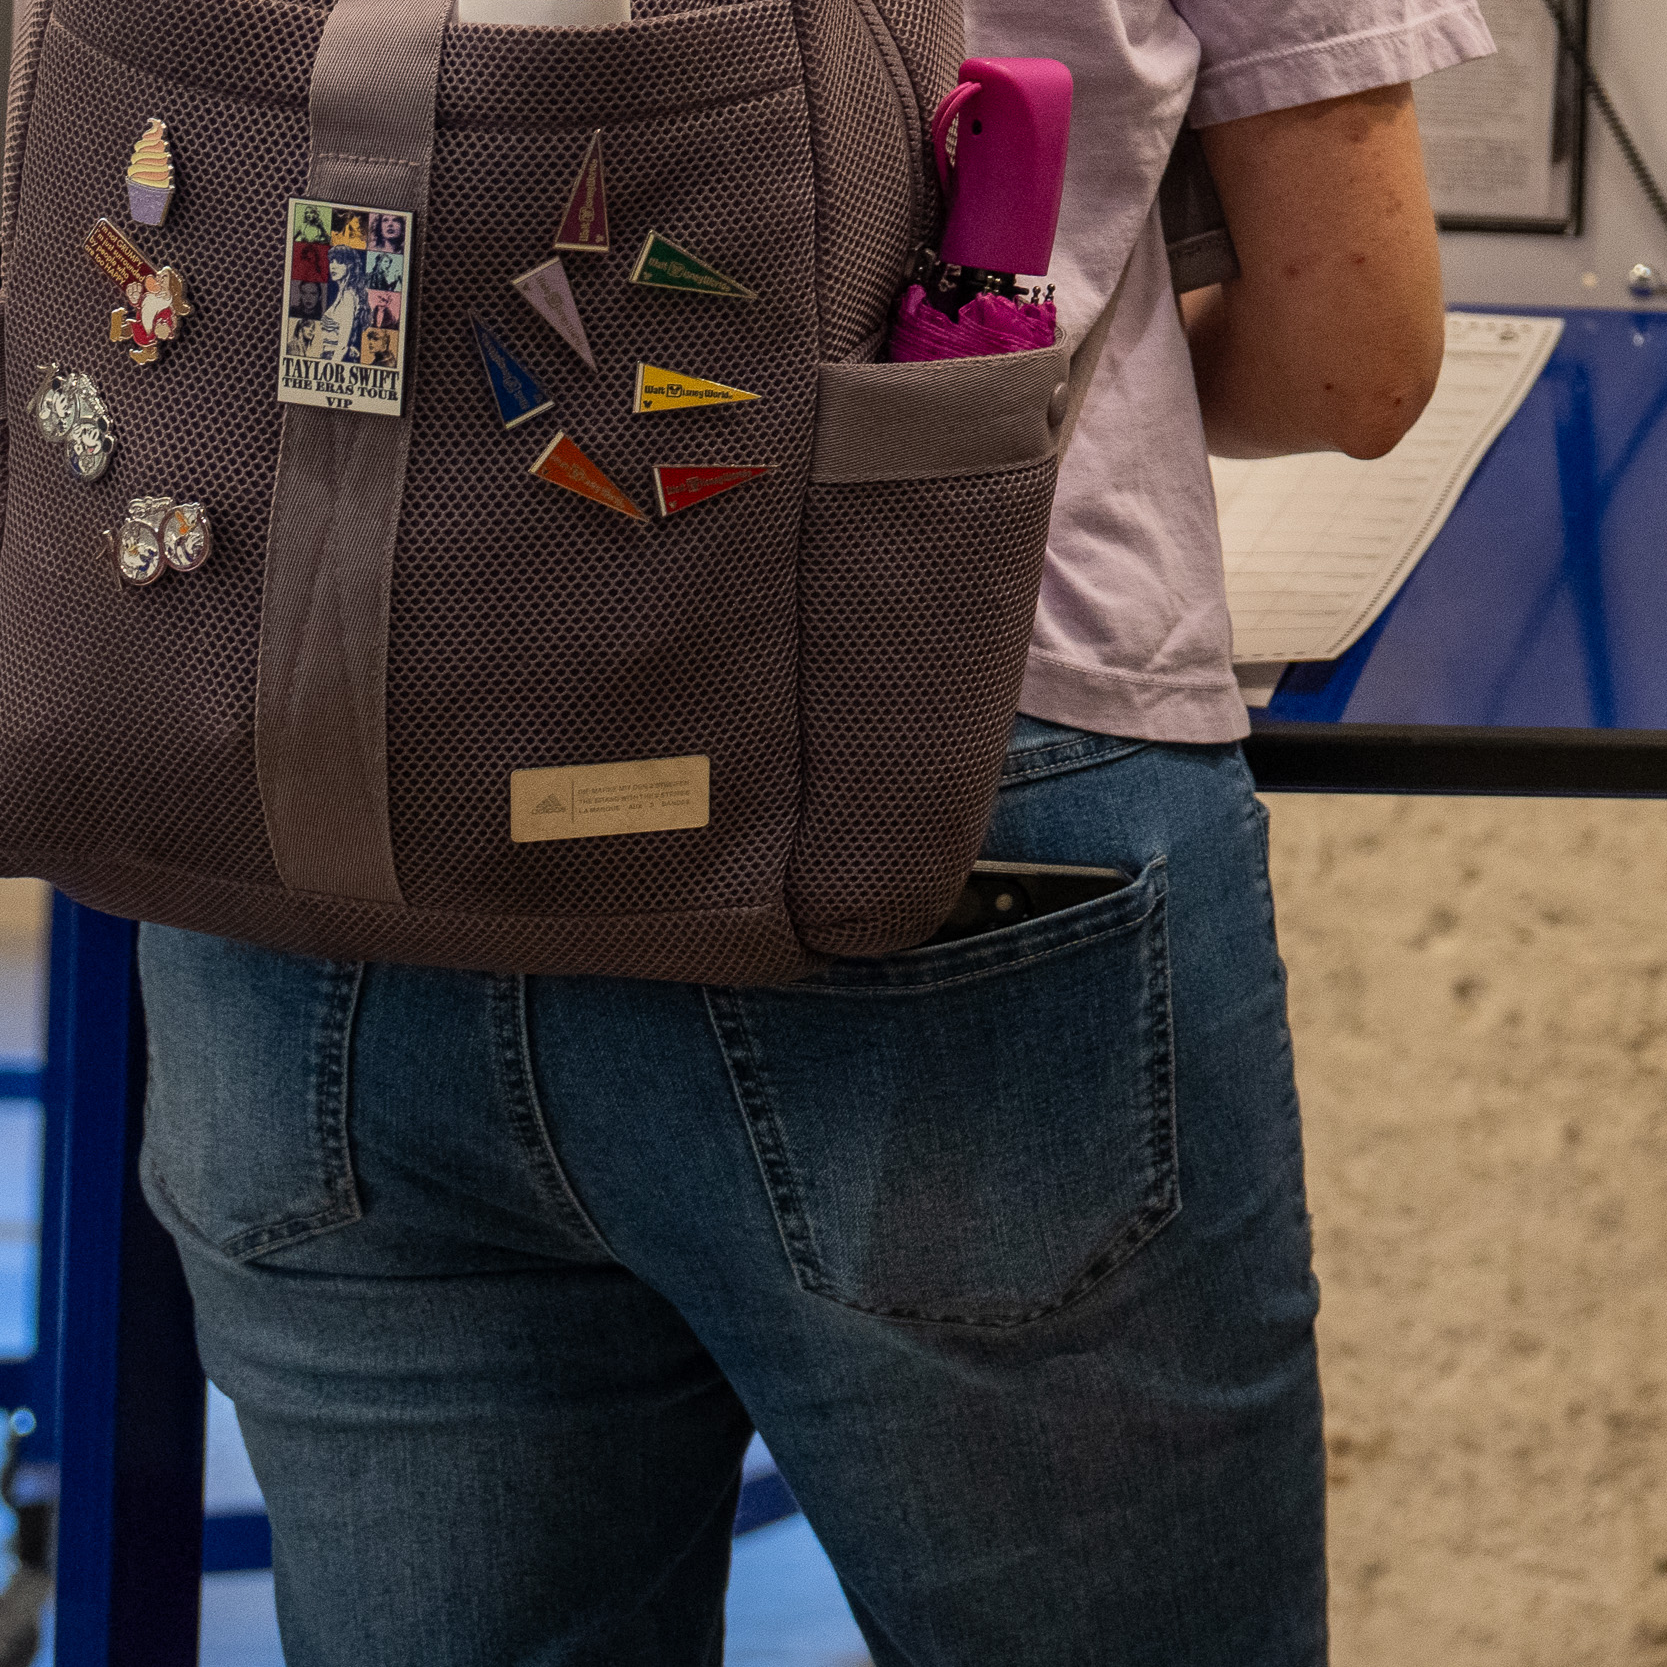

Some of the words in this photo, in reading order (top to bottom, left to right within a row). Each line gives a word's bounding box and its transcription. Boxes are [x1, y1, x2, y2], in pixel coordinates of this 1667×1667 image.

[108, 232, 118, 242] not
[84, 244, 95, 256] are
[95, 254, 104, 266] too
[90, 235, 98, 247] by
[96, 245, 116, 266] people
[117, 264, 129, 279] who
[102, 238, 114, 251] just
[114, 250, 146, 282] surrounded
[282, 357, 345, 384] TAYLOR
[349, 364, 400, 390] SWIFT
[282, 377, 312, 390] THE
[316, 381, 354, 396] ERAS
[358, 386, 398, 401] TOUR
[644, 385, 665, 394] Walt
[326, 396, 353, 408] VIP
